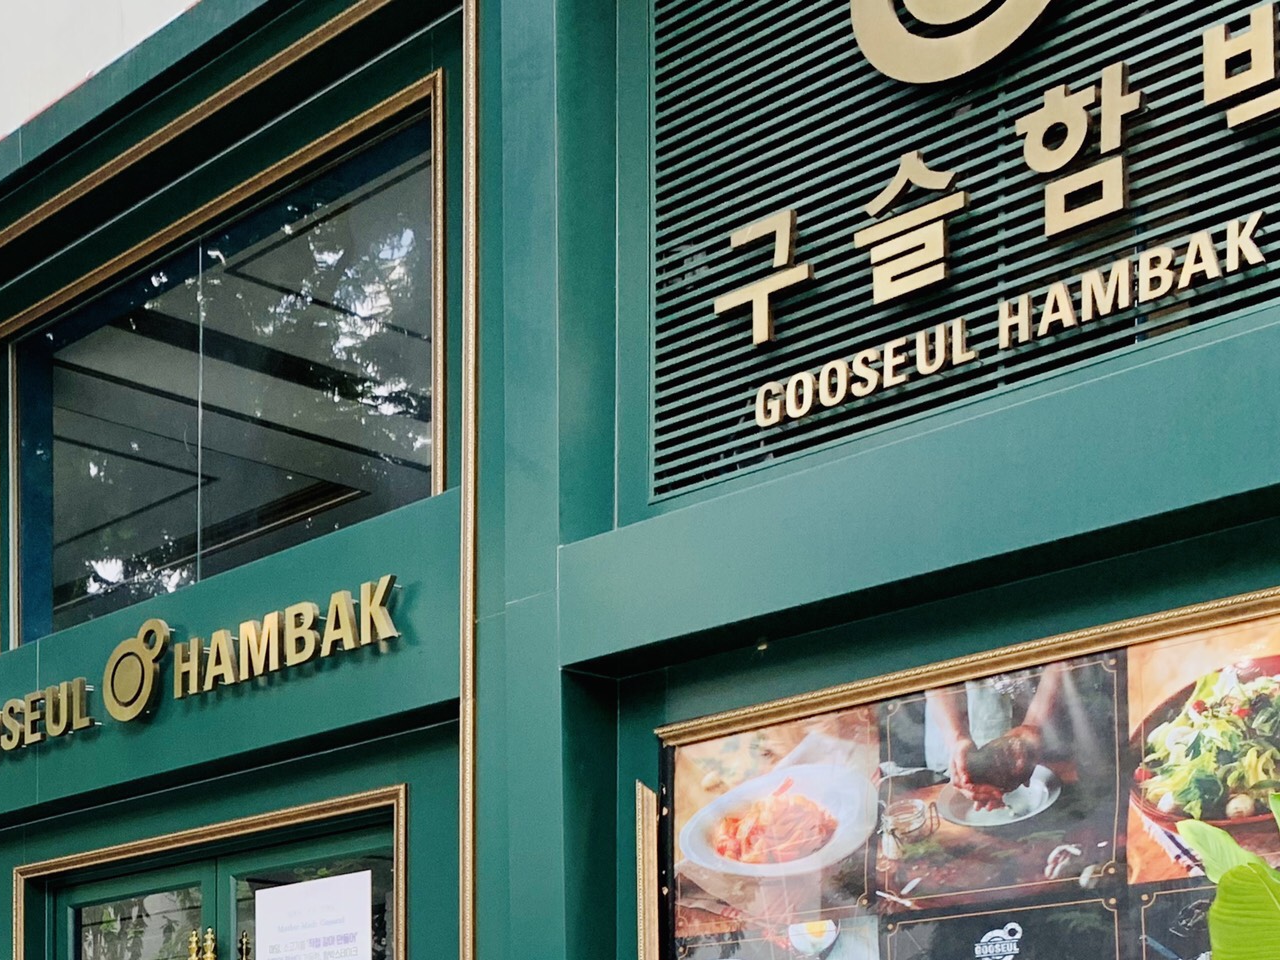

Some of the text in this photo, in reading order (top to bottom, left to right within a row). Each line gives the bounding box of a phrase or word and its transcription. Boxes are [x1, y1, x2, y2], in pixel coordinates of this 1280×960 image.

[754, 210, 1267, 428] GOOSEUL HAMBAK
[173, 574, 402, 700] HAMBAK
[974, 942, 1020, 955] GOOSEUL
